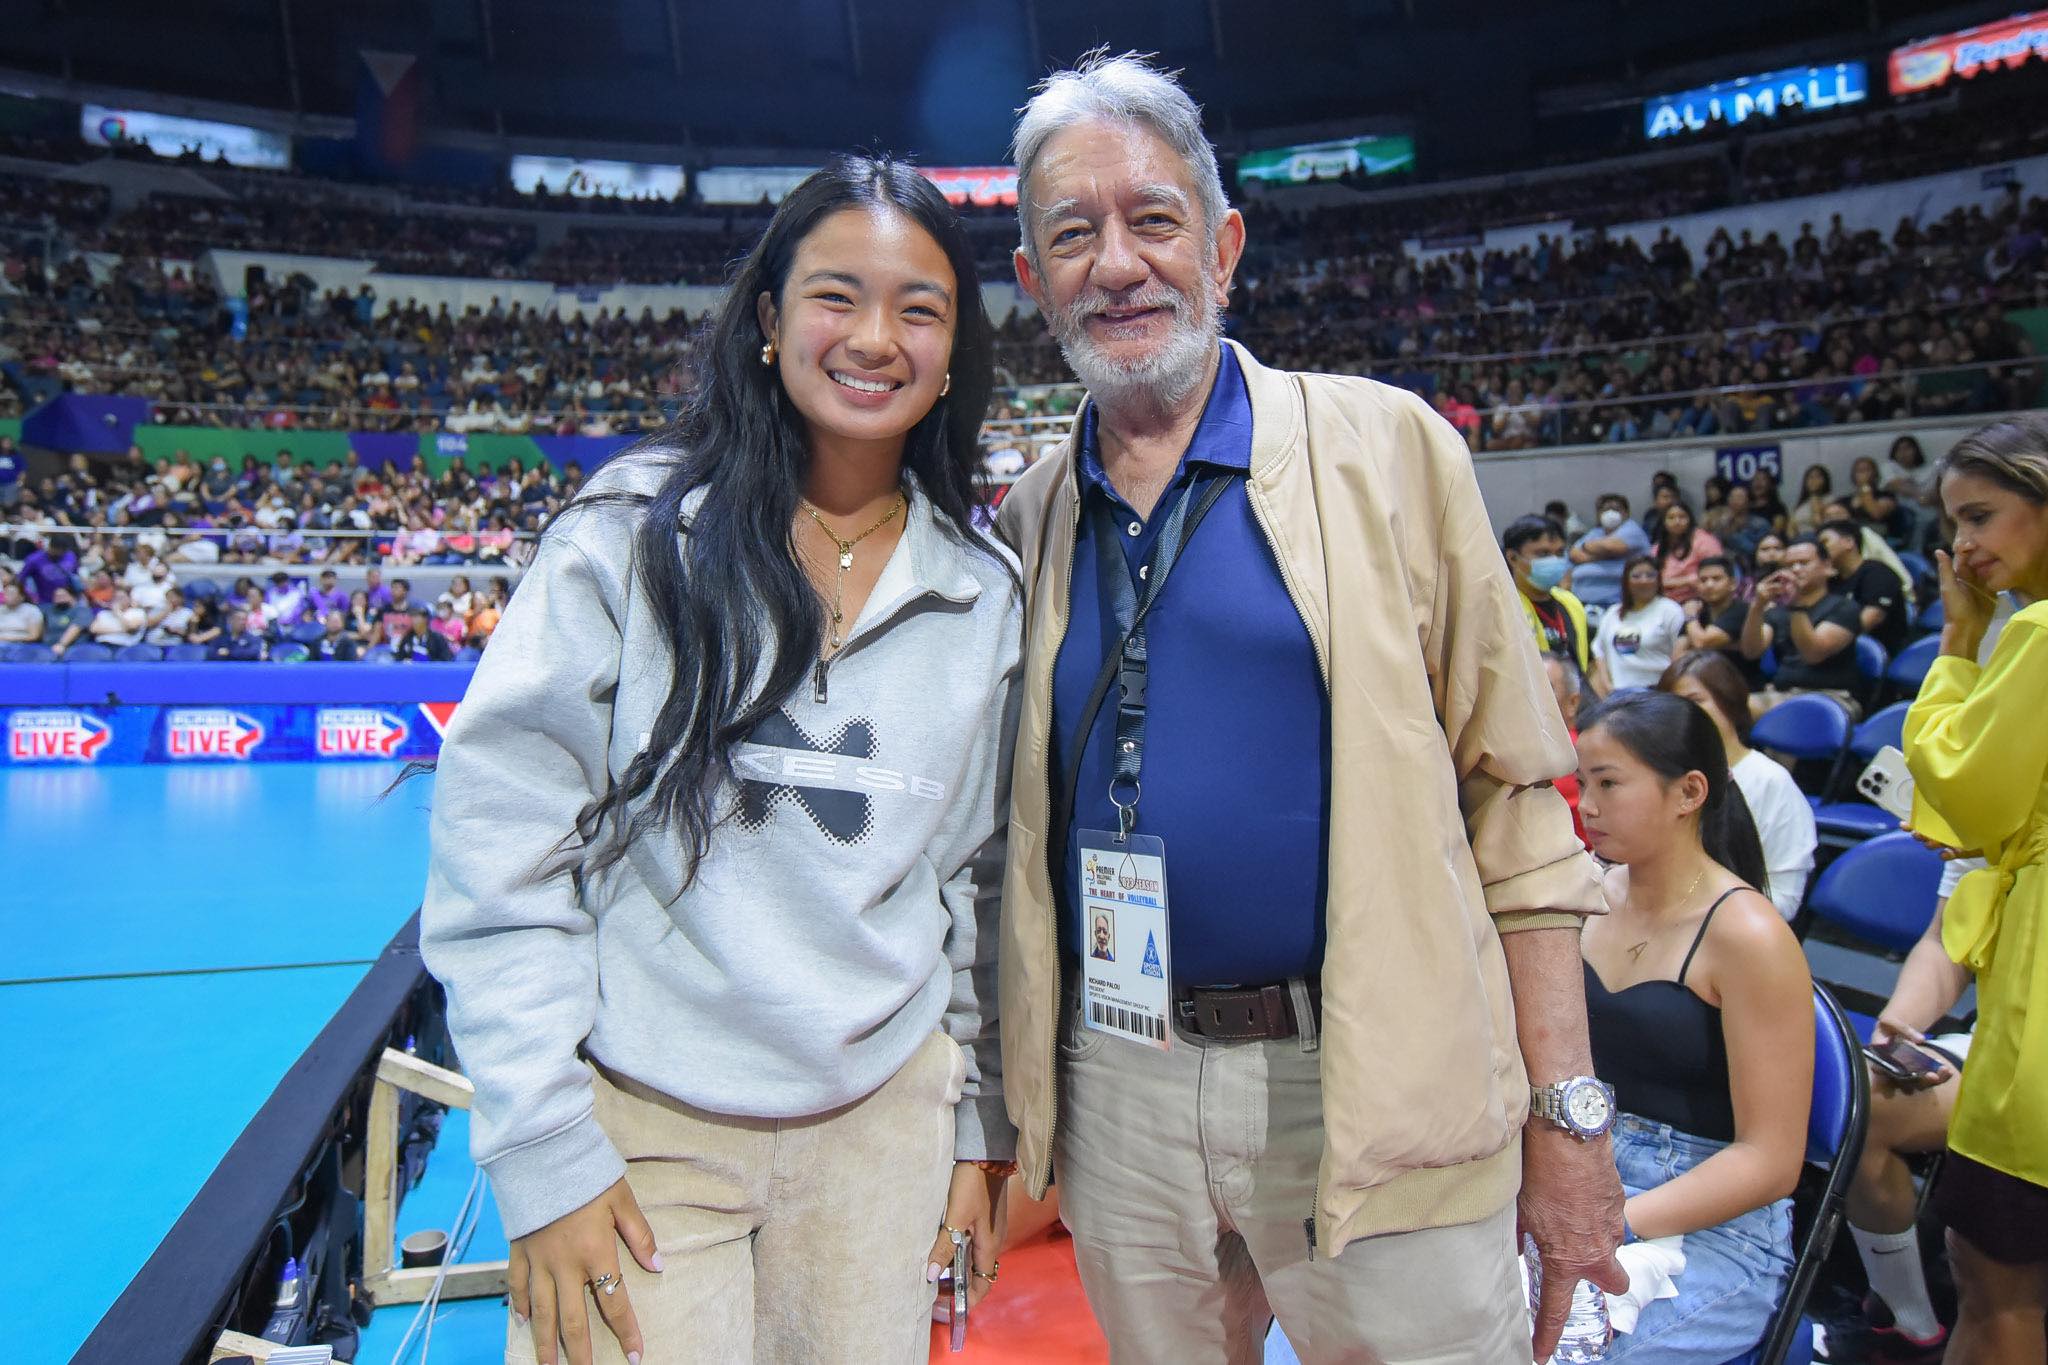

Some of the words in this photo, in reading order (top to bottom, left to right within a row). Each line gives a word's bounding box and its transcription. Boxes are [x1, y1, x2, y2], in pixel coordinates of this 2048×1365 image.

[1648, 98, 1722, 139] ALI
[1734, 73, 1866, 123] MALL
[1717, 450, 1779, 482] 105
[15, 731, 76, 757] LIVE
[172, 729, 230, 754] LIVE
[321, 728, 377, 753] LIVE
[1089, 887, 1098, 896] THE
[1100, 889, 1115, 899] HEART
[1127, 893, 1158, 906] VOLLEYBALL
[1088, 976, 1106, 987] RICHARD
